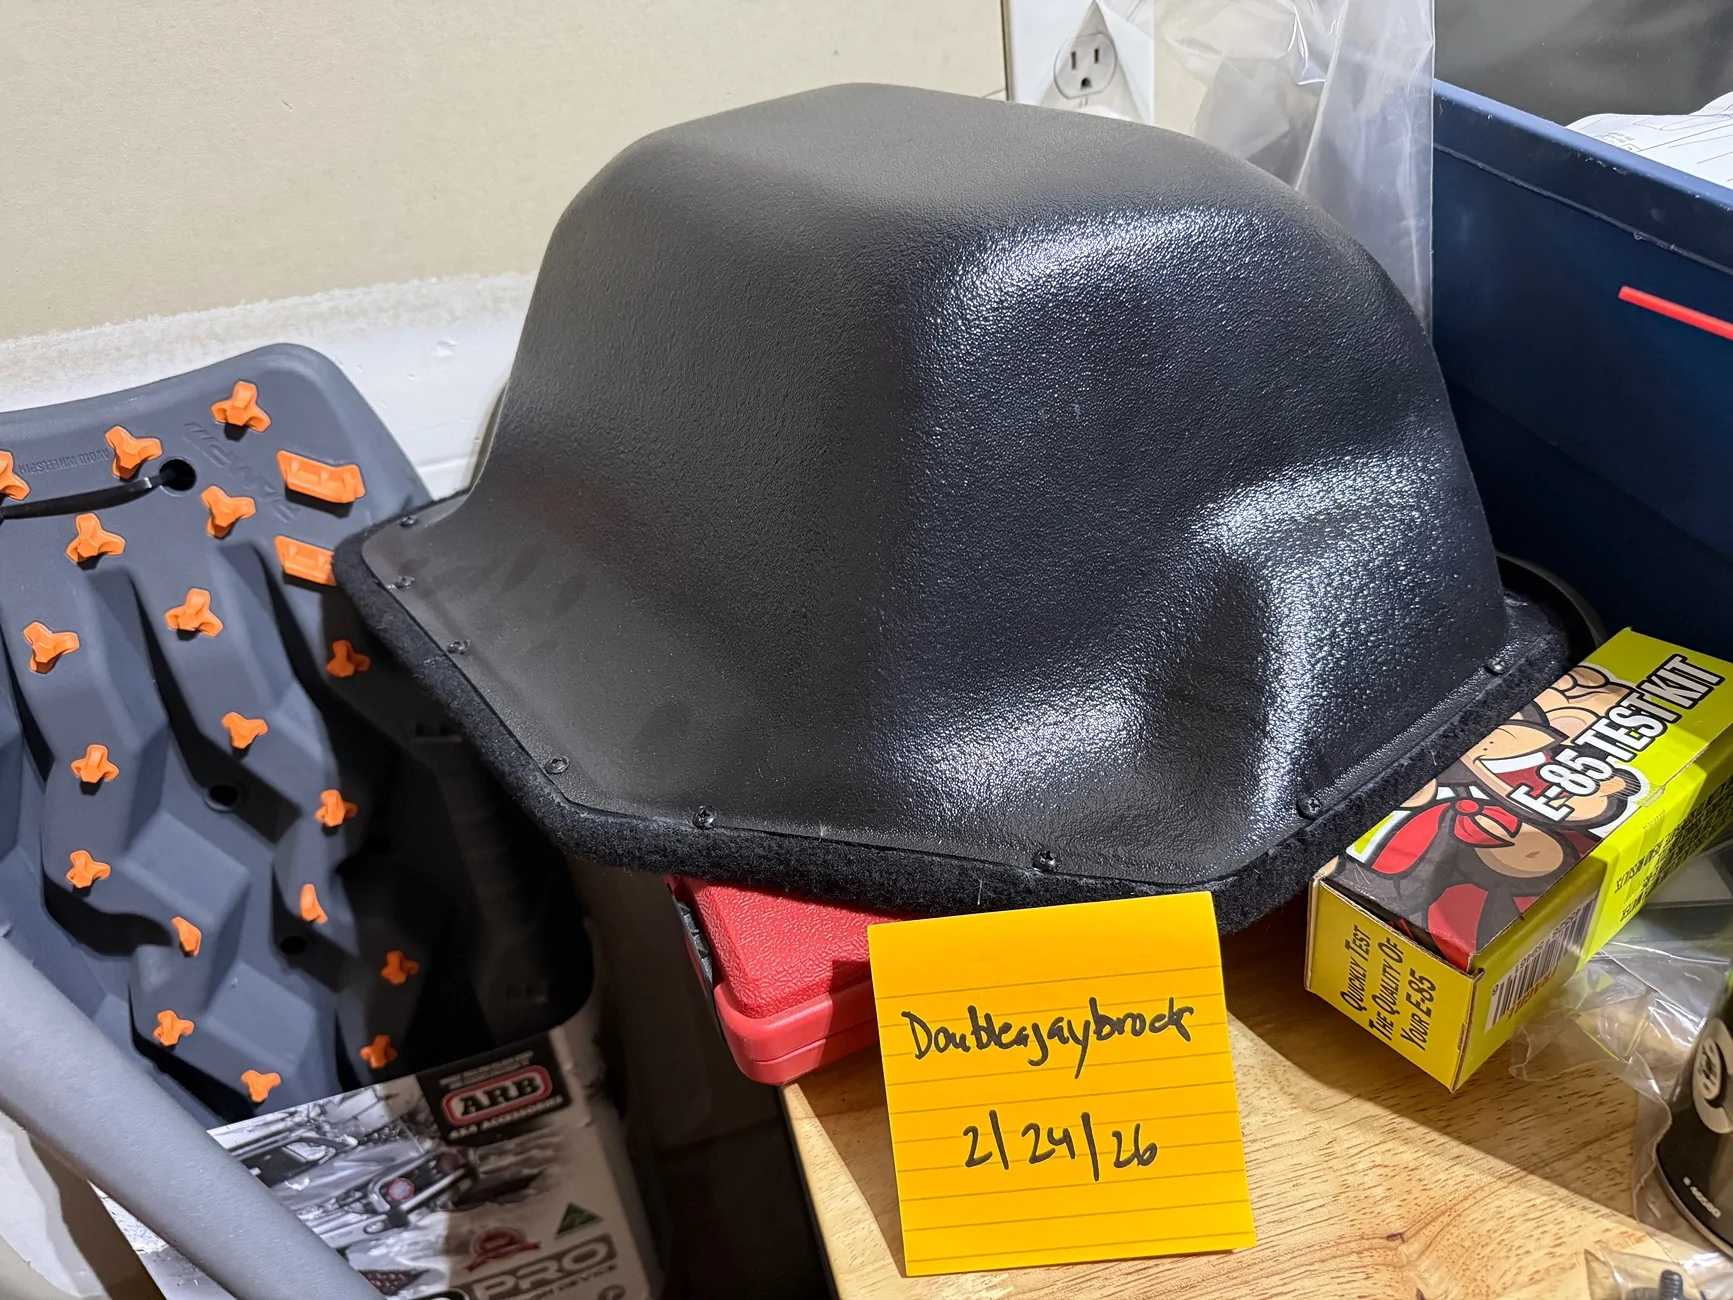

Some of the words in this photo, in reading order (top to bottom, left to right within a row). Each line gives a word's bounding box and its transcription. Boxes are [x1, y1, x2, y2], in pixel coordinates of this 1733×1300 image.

[18, 454, 78, 475] WHEELSPIN
[1508, 746, 1615, 823] E-85
[1572, 688, 1683, 763] TEST
[1638, 653, 1725, 709] KIT
[1344, 923, 1371, 962] TEST
[1377, 936, 1405, 964] OF
[1339, 956, 1368, 1012] QUICKLY
[1371, 958, 1402, 1016] QUALITY
[1405, 967, 1437, 1019] E-85
[1368, 1010, 1395, 1041] THE
[1400, 1012, 1430, 1052] YOUR
[459, 1076, 541, 1117] ARB
[473, 1240, 610, 1300] PRO
